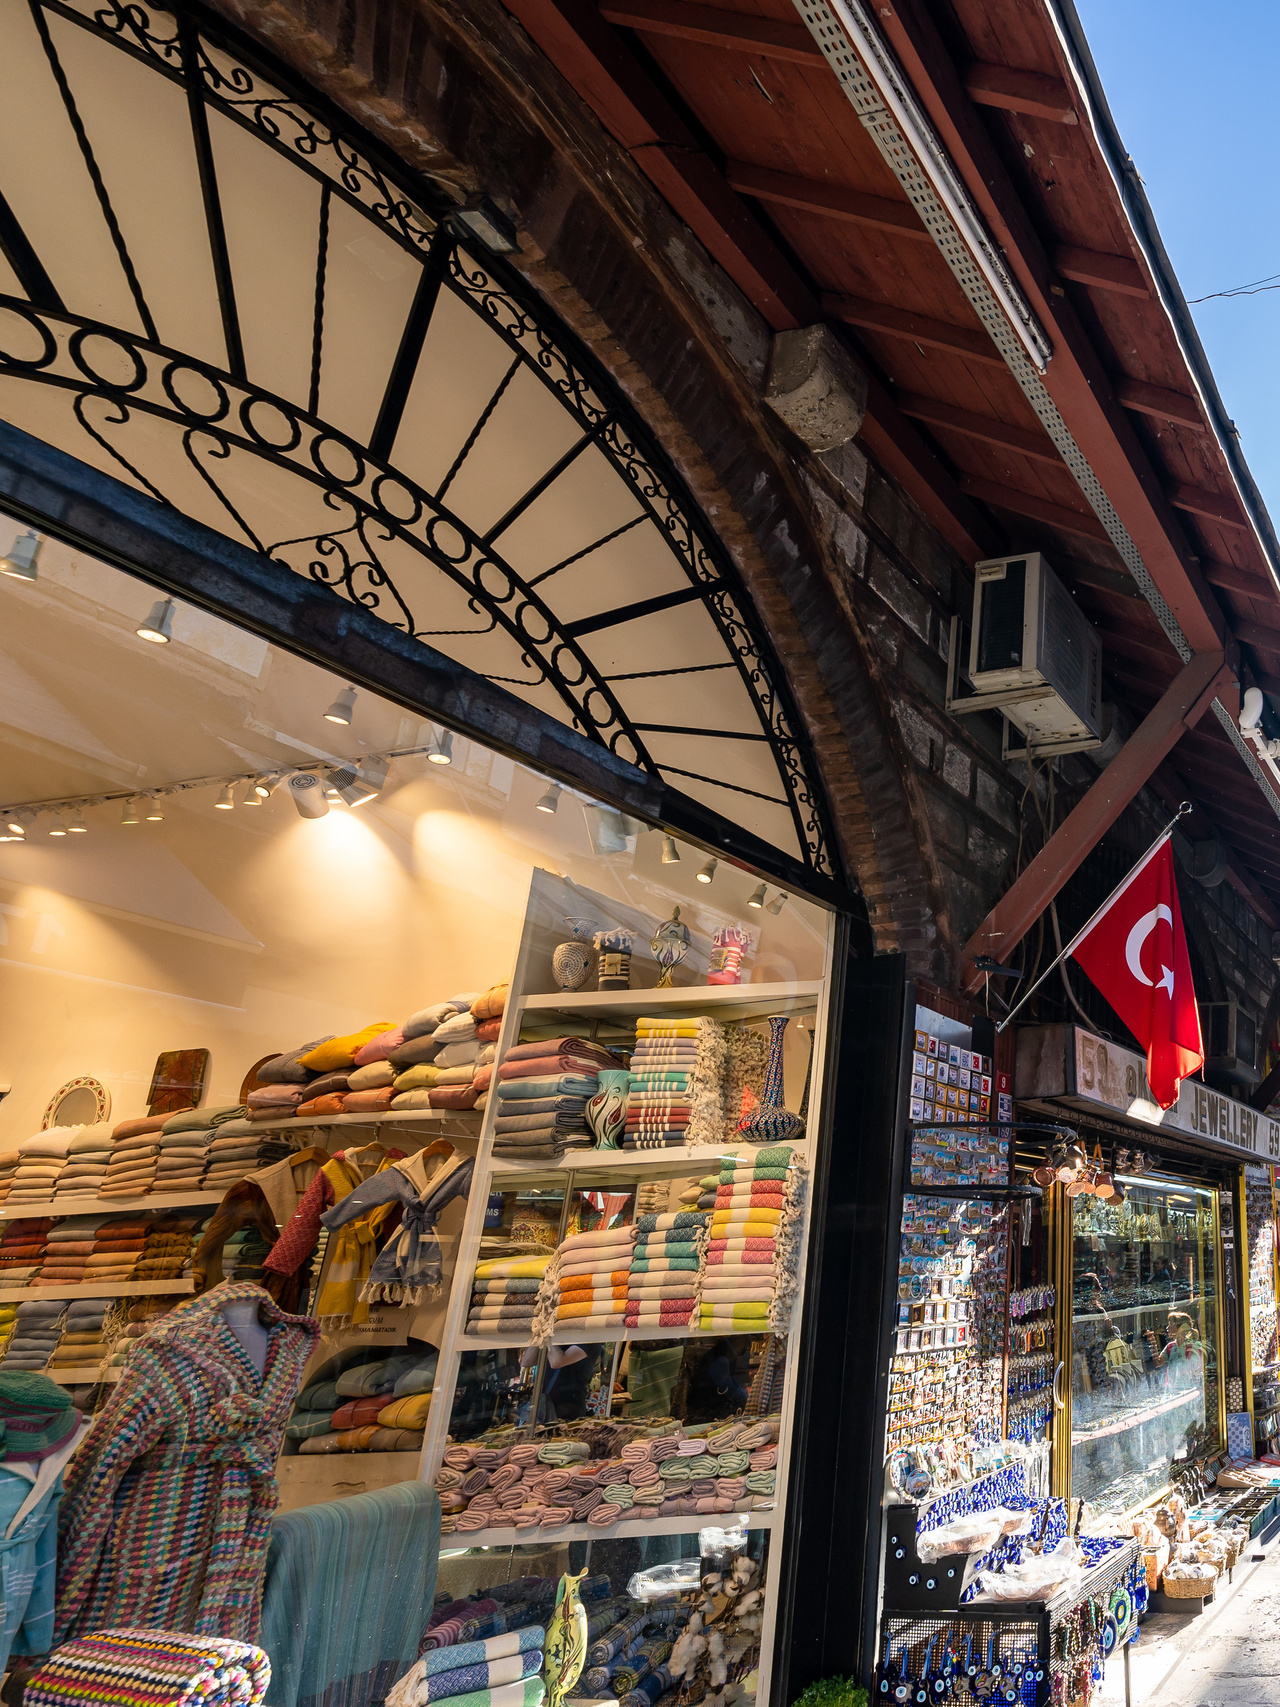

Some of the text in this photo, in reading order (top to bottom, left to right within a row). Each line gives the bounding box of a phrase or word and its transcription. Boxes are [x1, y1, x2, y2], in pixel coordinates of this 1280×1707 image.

[1001, 1076, 1006, 1089] 9
[1190, 1086, 1259, 1151] JEWELLERY
[1269, 1121, 1280, 1156] 59
